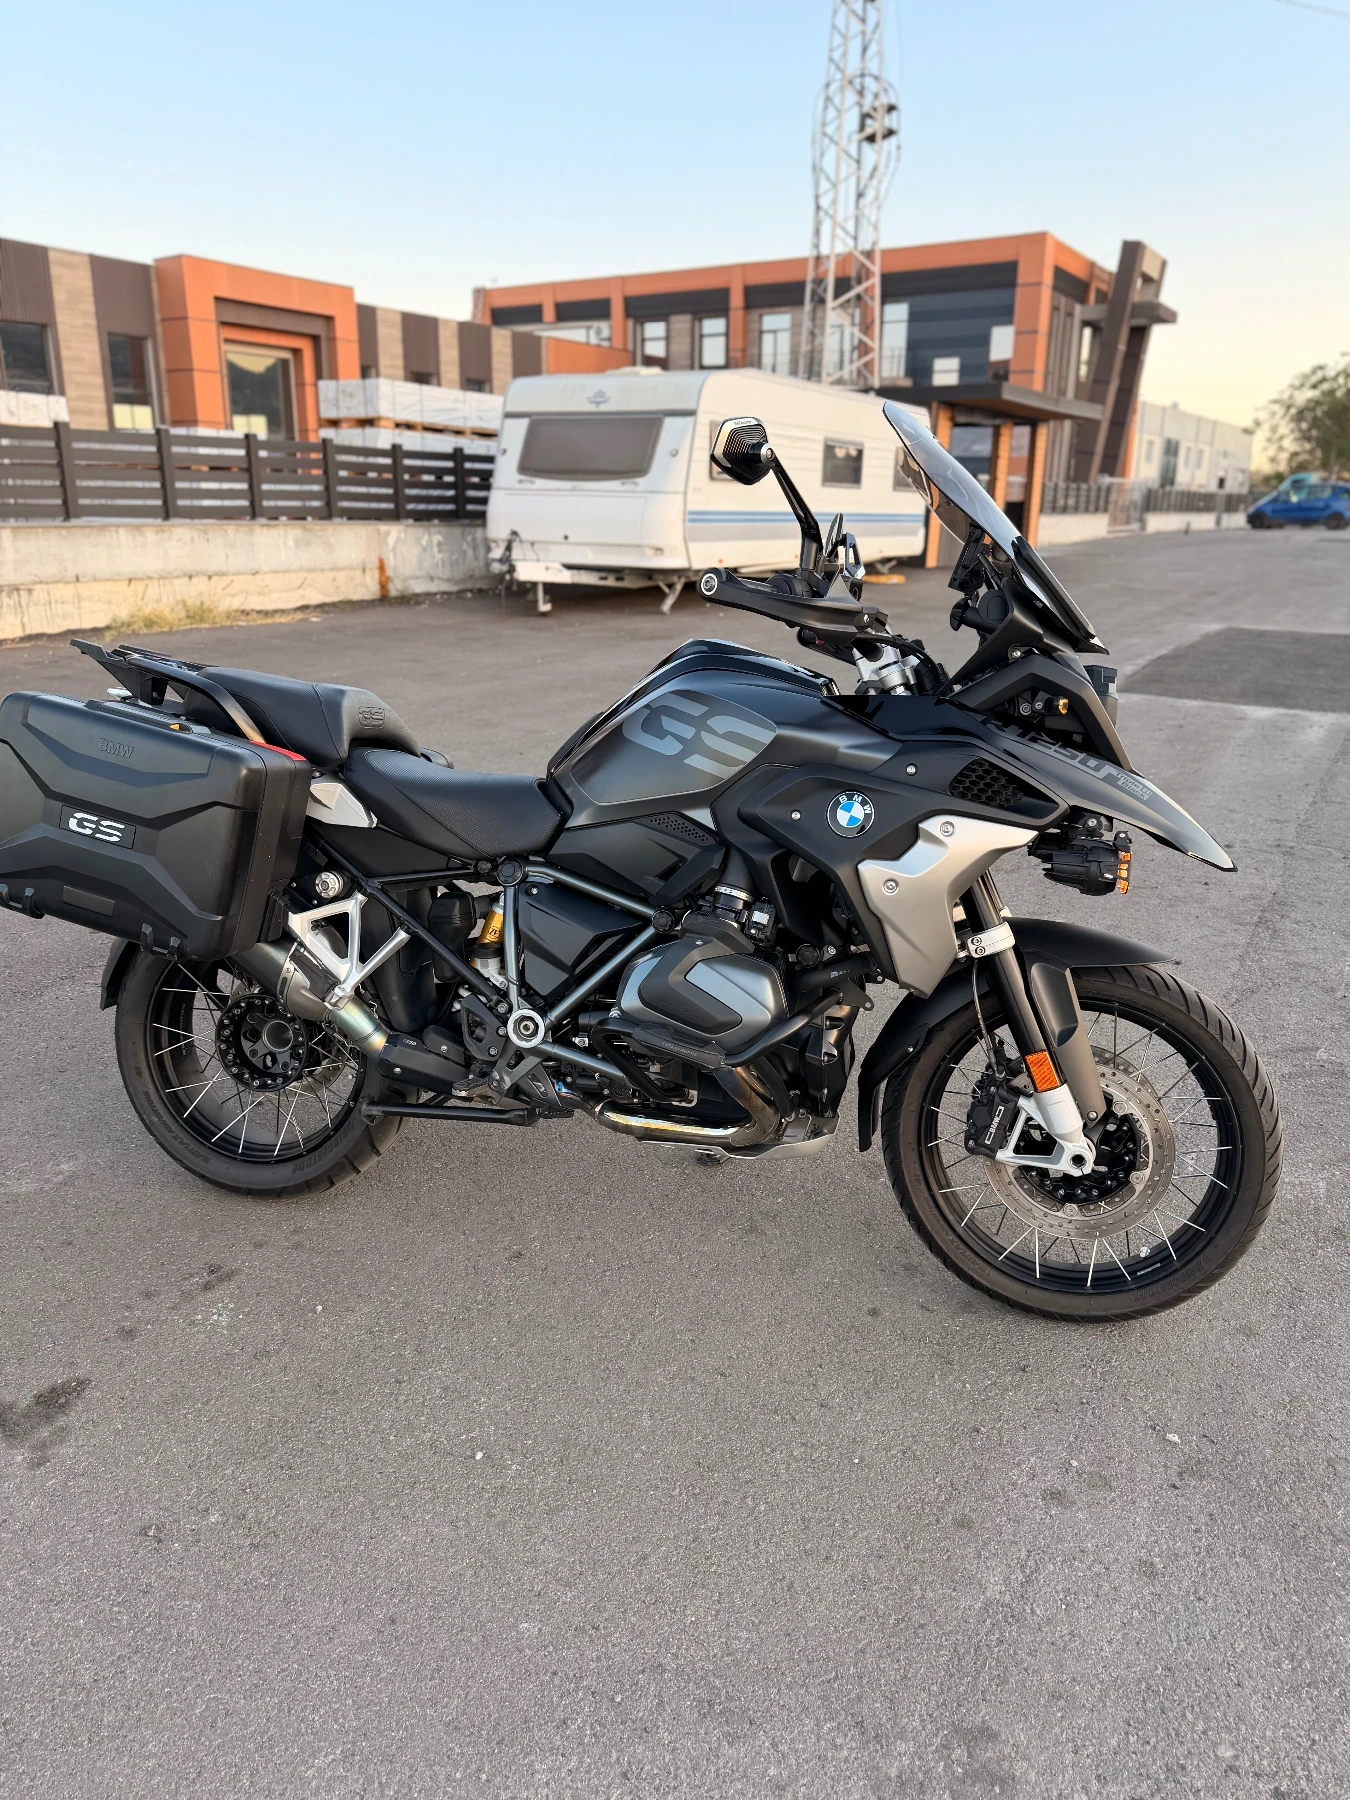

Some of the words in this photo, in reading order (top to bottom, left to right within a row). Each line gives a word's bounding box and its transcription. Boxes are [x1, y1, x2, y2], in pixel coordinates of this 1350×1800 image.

[358, 706, 385, 729] GS
[622, 692, 777, 780] GS
[98, 737, 135, 759] BMW
[1115, 770, 1140, 789] Triple
[1120, 781, 1148, 800] Black
[838, 794, 872, 814] BMW
[68, 812, 126, 842] GS
[291, 1117, 356, 1174] BRIDGESTONE
